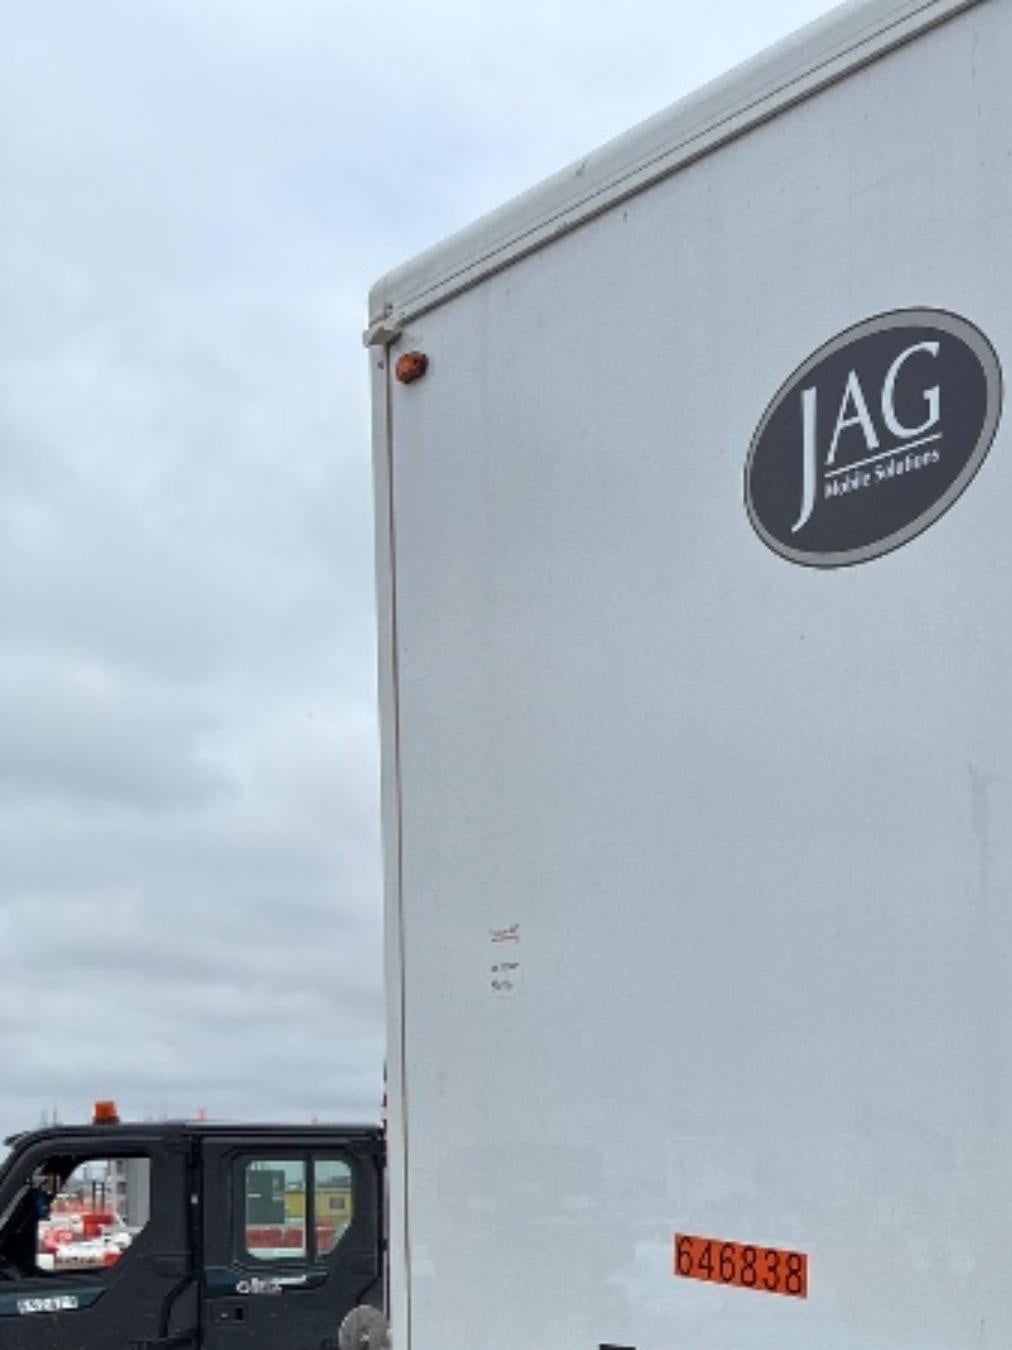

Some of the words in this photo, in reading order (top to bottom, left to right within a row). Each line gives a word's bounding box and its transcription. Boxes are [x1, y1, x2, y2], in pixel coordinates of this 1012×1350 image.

[791, 341, 941, 534] JAG
[874, 449, 940, 483] Solutions
[677, 1235, 802, 1295] 646838
